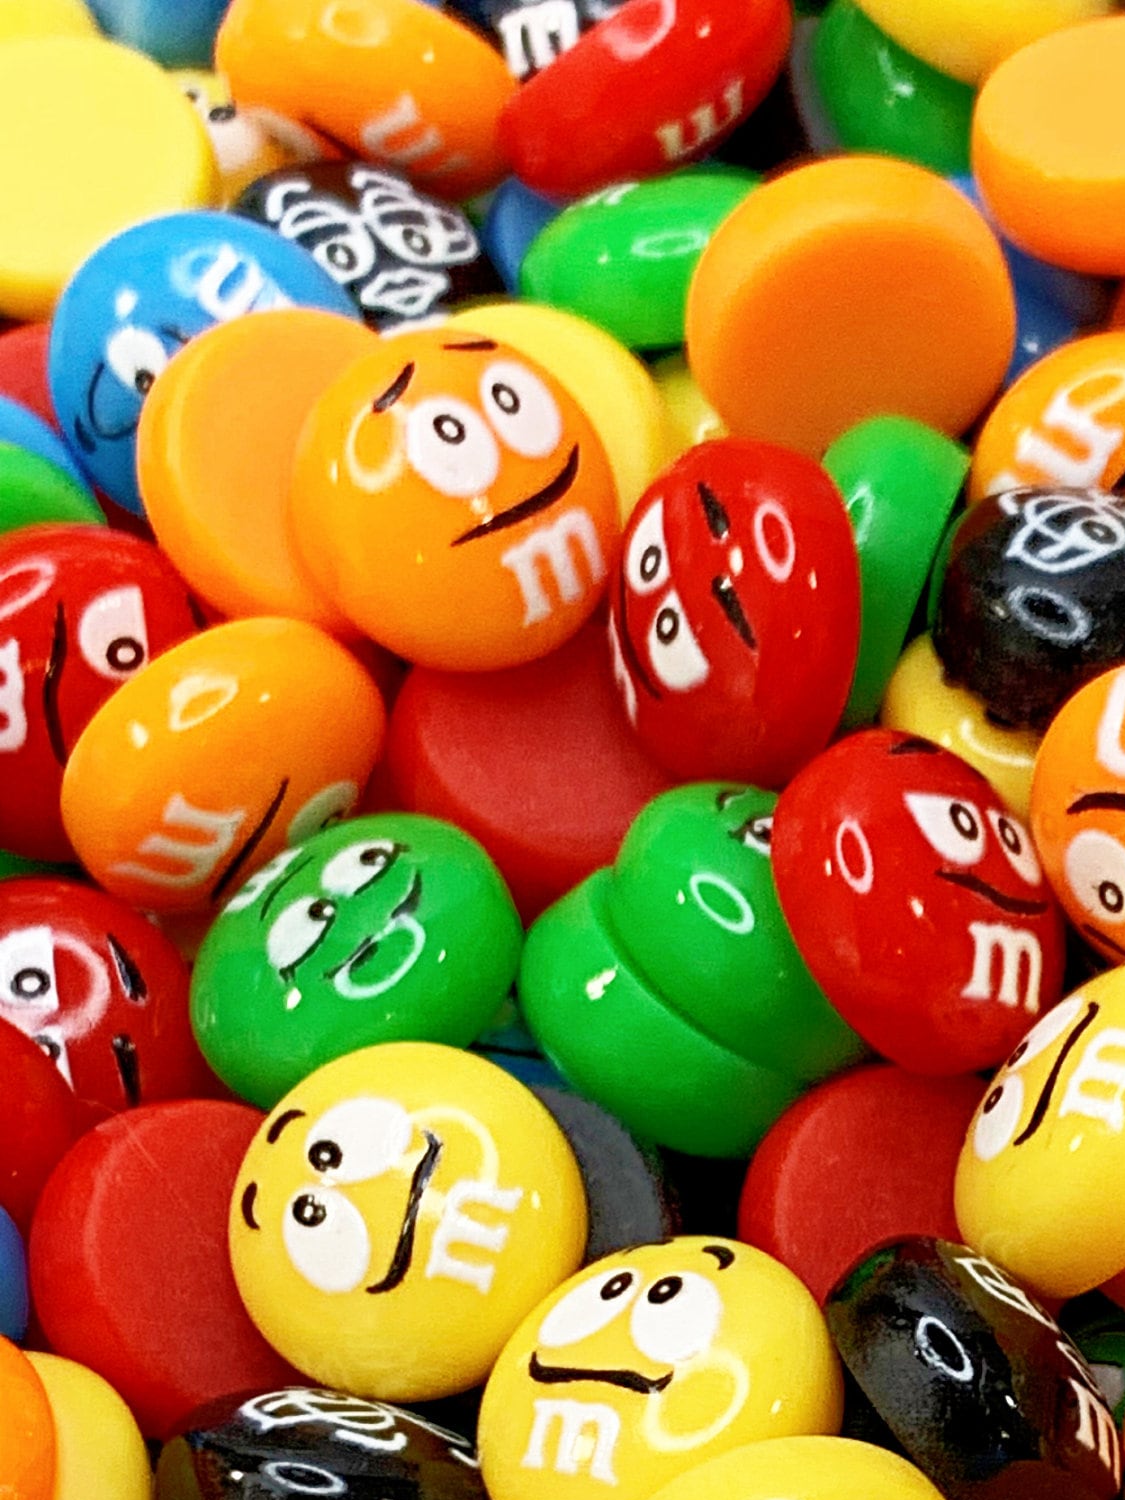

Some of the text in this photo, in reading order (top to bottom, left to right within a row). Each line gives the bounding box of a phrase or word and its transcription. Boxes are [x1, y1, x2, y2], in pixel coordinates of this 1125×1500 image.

[502, 508, 605, 626] m
[963, 923, 1041, 1013] m
[425, 1180, 522, 1295] m
[521, 1399, 624, 1485] m
